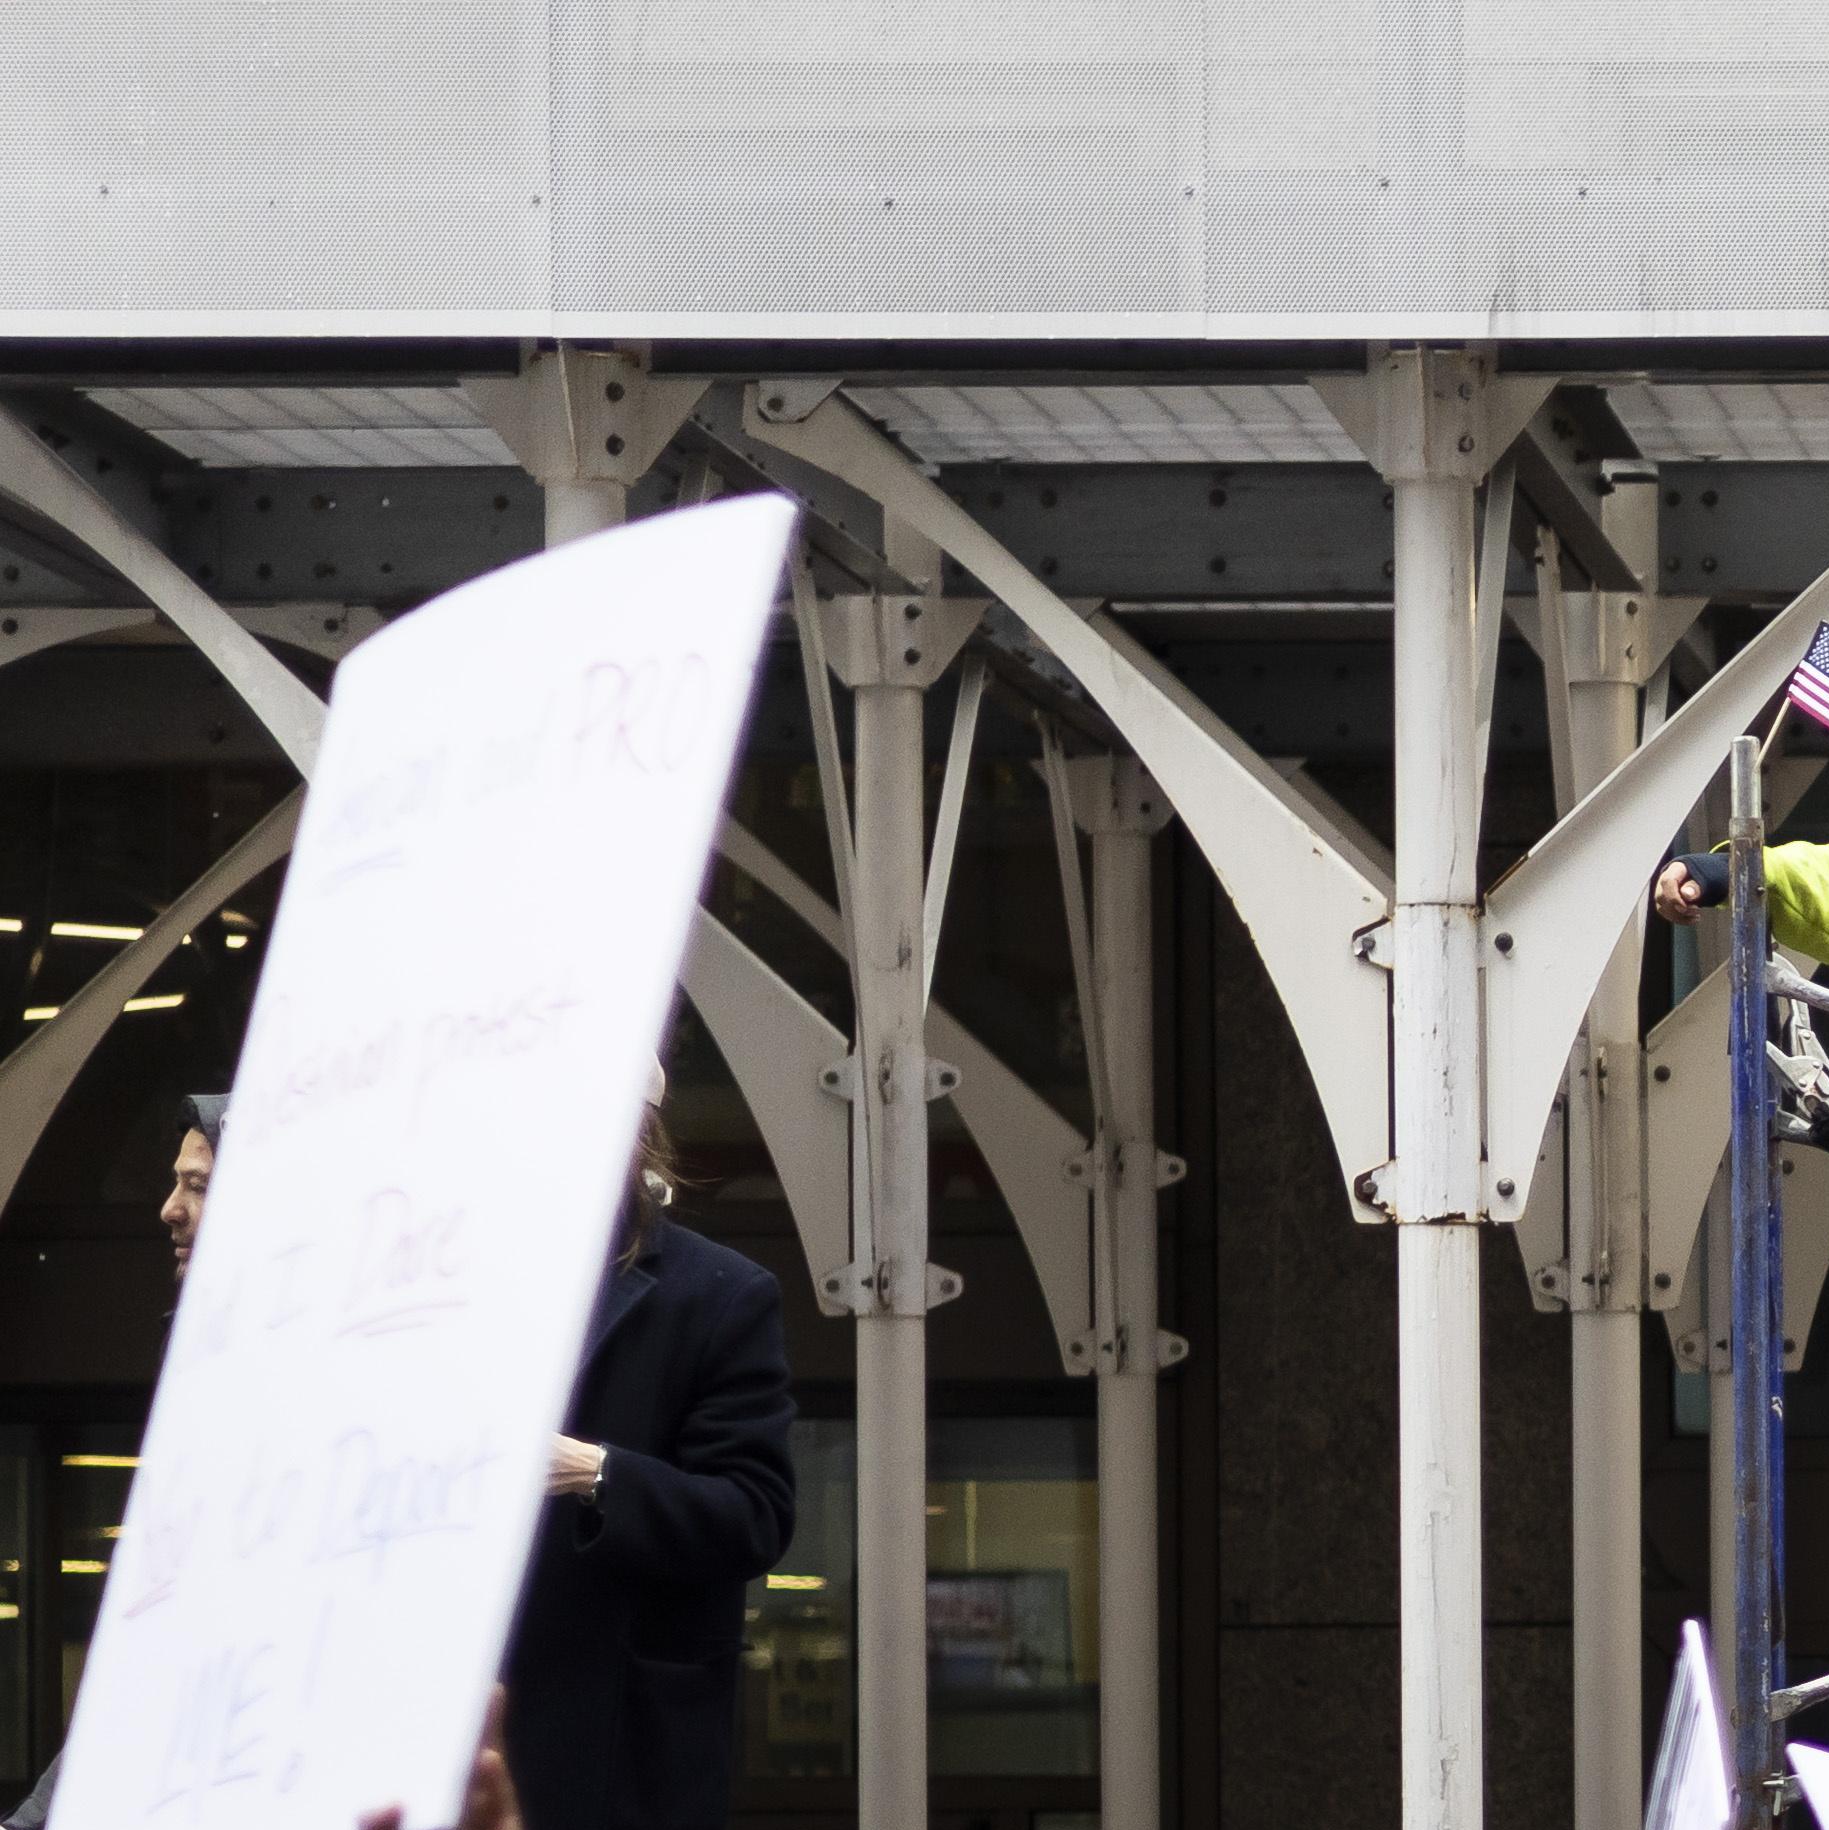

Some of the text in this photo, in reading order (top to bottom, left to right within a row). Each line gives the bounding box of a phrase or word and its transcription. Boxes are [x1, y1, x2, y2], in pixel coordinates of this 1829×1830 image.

[561, 648, 712, 789] PRO
[403, 964, 585, 1142] protest
[263, 1238, 320, 1333] I
[337, 1185, 468, 1314] Dare
[232, 1431, 304, 1560] to
[304, 1424, 508, 1584] Deport
[145, 1593, 337, 1824] ME!
